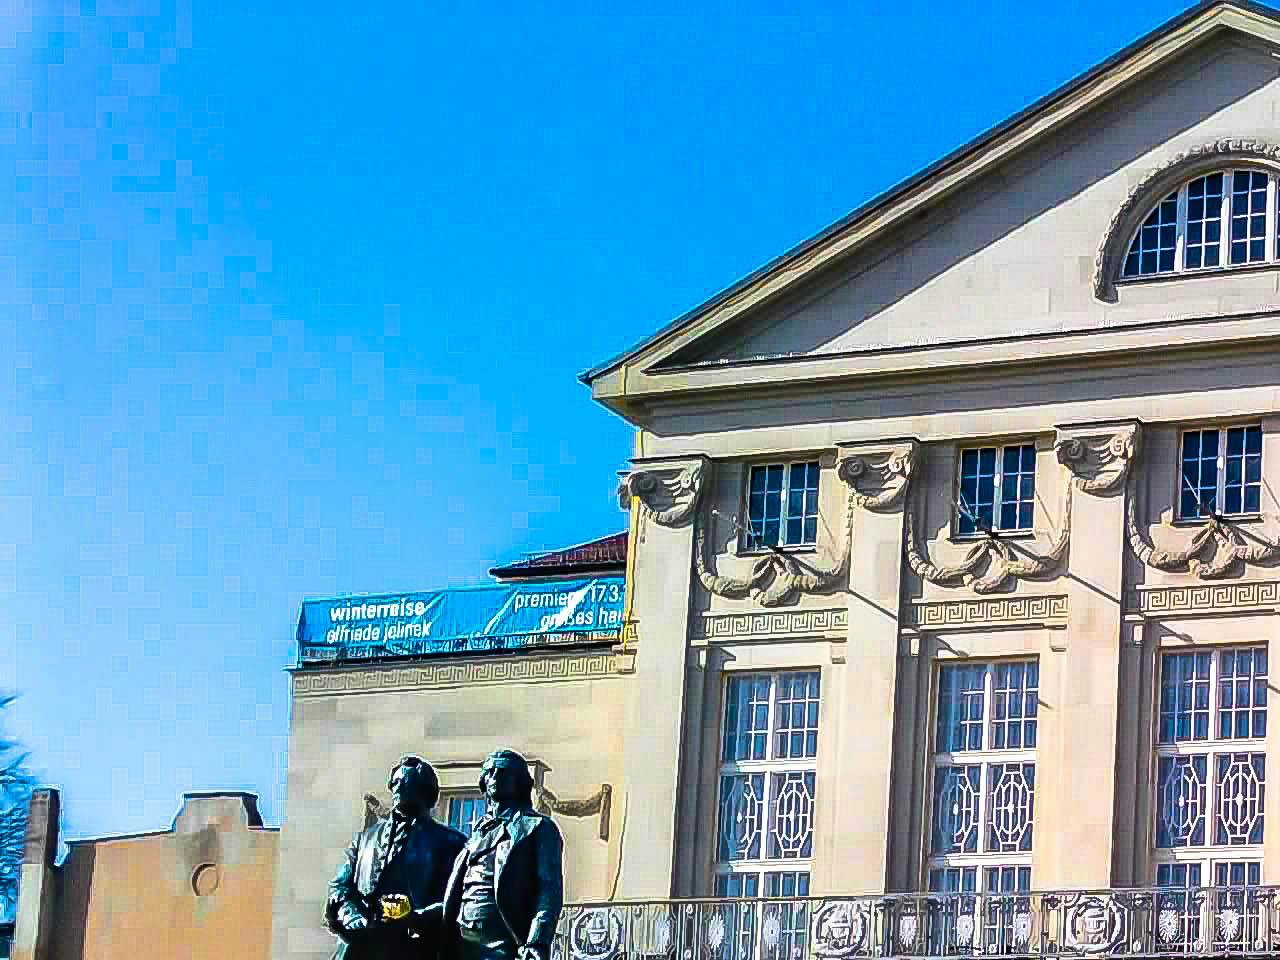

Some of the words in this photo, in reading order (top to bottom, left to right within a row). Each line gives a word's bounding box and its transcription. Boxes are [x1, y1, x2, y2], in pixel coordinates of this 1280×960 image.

[330, 598, 426, 622] winterreise
[514, 588, 583, 612] premier
[326, 623, 381, 645] elfriede
[382, 618, 432, 645] jelinek
[541, 610, 594, 634] gres
